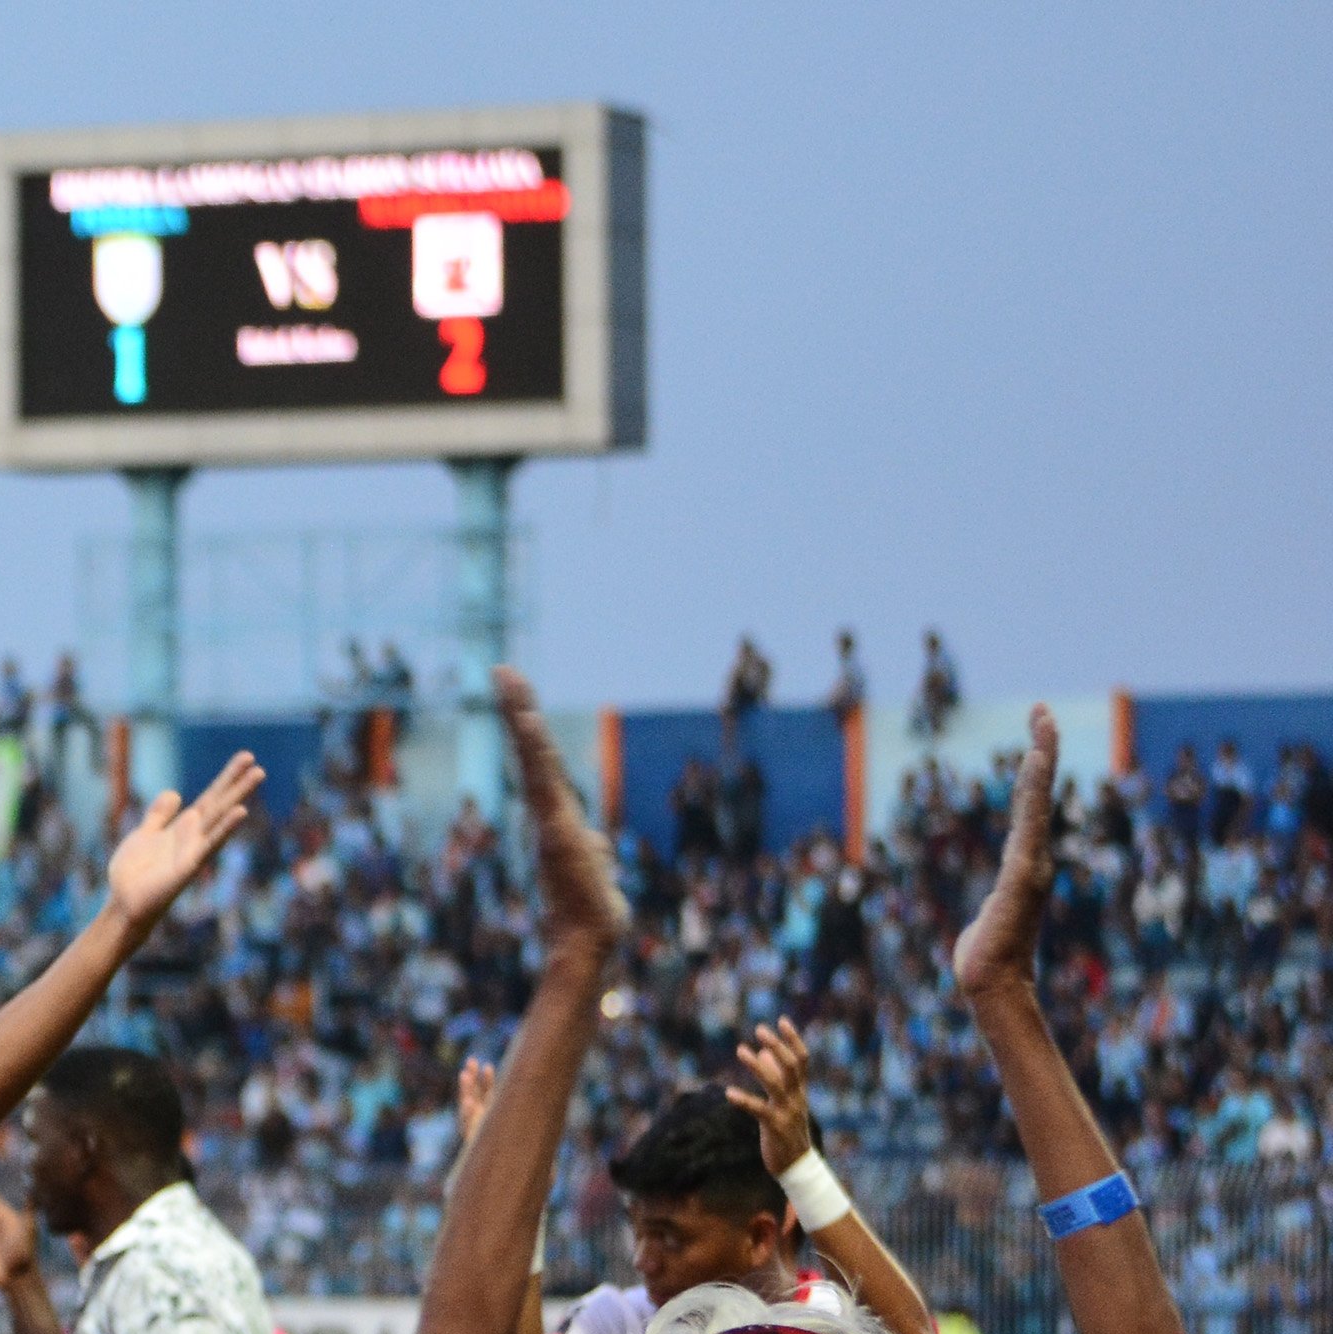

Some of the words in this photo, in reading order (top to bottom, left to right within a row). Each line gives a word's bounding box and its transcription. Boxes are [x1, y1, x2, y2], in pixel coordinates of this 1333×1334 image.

[254, 239, 340, 311] VS
[109, 322, 146, 404] 1
[438, 316, 487, 395] 2
